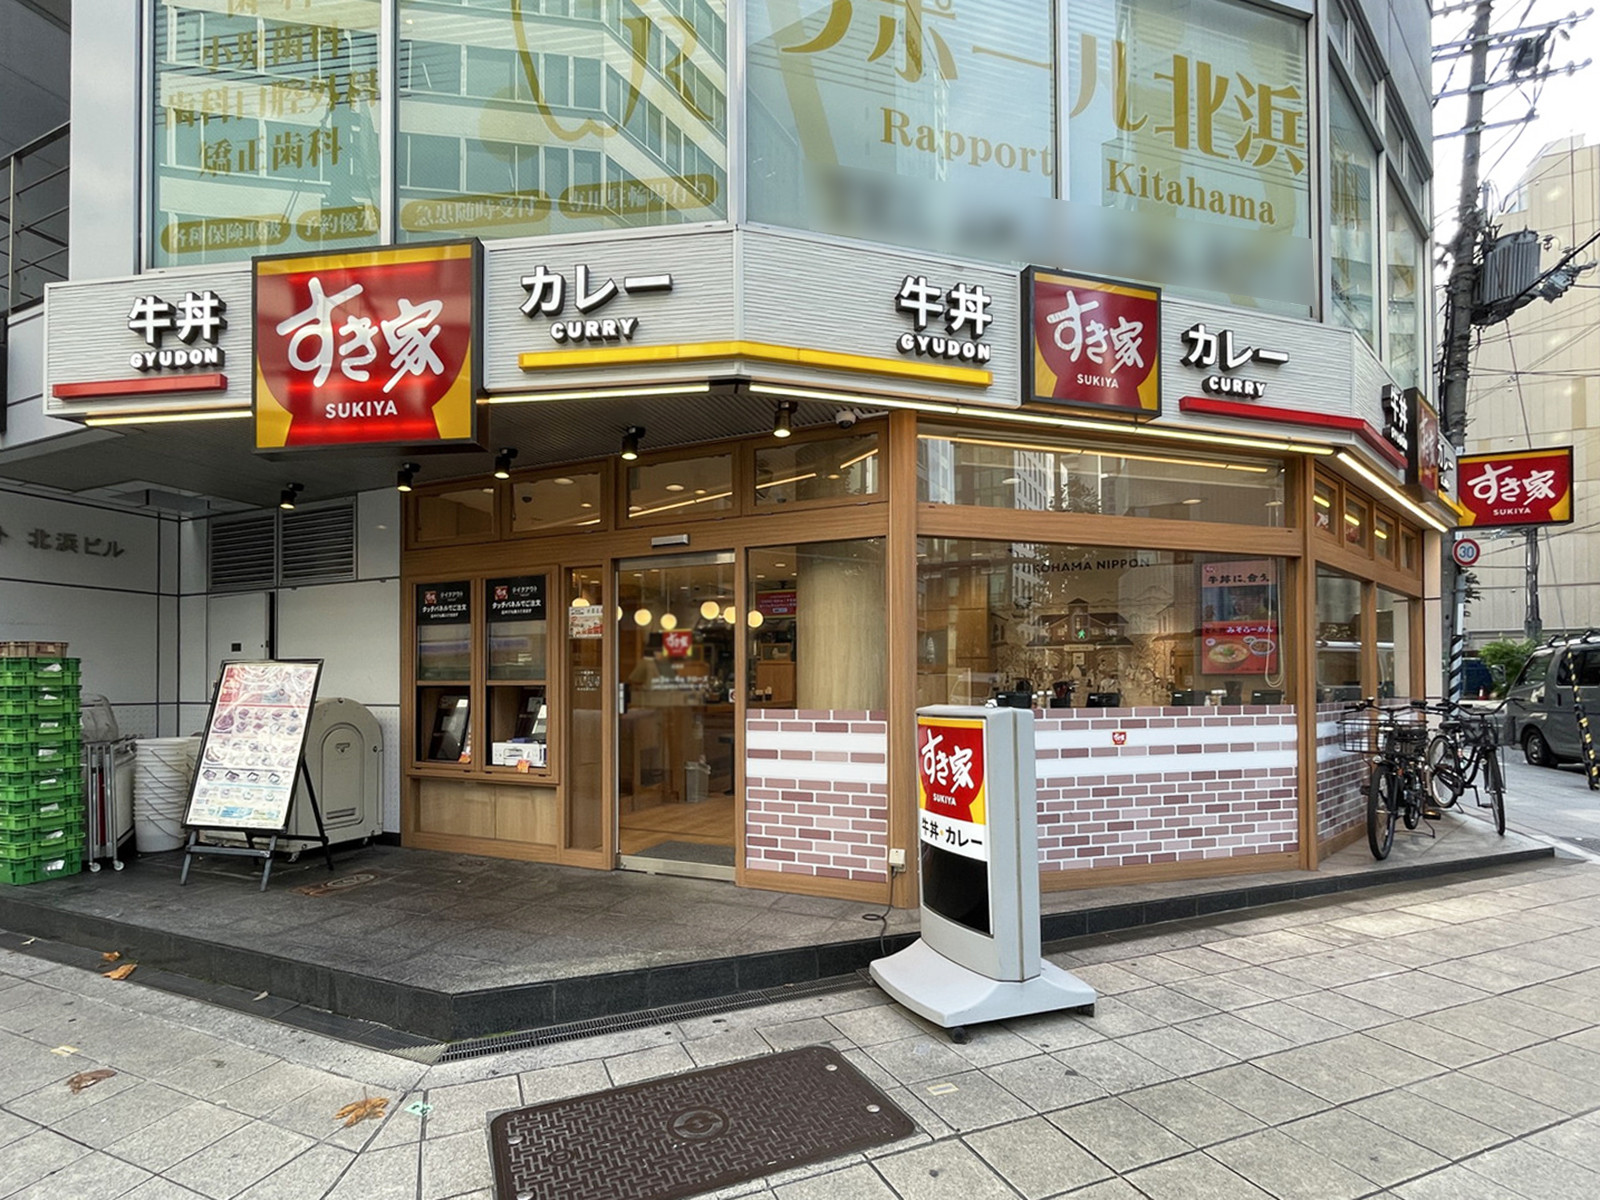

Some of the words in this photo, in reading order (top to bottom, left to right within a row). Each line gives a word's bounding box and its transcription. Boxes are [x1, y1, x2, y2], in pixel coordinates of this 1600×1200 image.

[198, 126, 342, 177] 矯正歯科
[880, 107, 1054, 177] Rapport
[1106, 157, 1276, 226] Kitahama
[305, 208, 378, 237] 予約優先
[519, 265, 673, 318] カレー
[128, 291, 225, 347] 牛丼
[897, 276, 994, 338] 牛丼
[276, 276, 445, 394] すき家
[551, 316, 638, 343] CURRY
[1046, 290, 1145, 375] すき家
[129, 347, 223, 370] GYUDON
[898, 333, 993, 362] GYUDON
[1182, 323, 1290, 372] カレー
[1076, 373, 1119, 389] SUKIYA
[1206, 375, 1267, 399] CURRY
[325, 400, 398, 419] SUKIYA
[1467, 464, 1556, 506] すき家
[1493, 507, 1531, 516] SUKIYA
[28, 528, 125, 558] 北浜ビル
[1459, 545, 1475, 559] 30
[1097, 558, 1150, 570] NIPPON
[922, 729, 974, 794] すき家
[933, 792, 957, 806] SUKIYA
[922, 817, 983, 848] 牛丼・カレー
